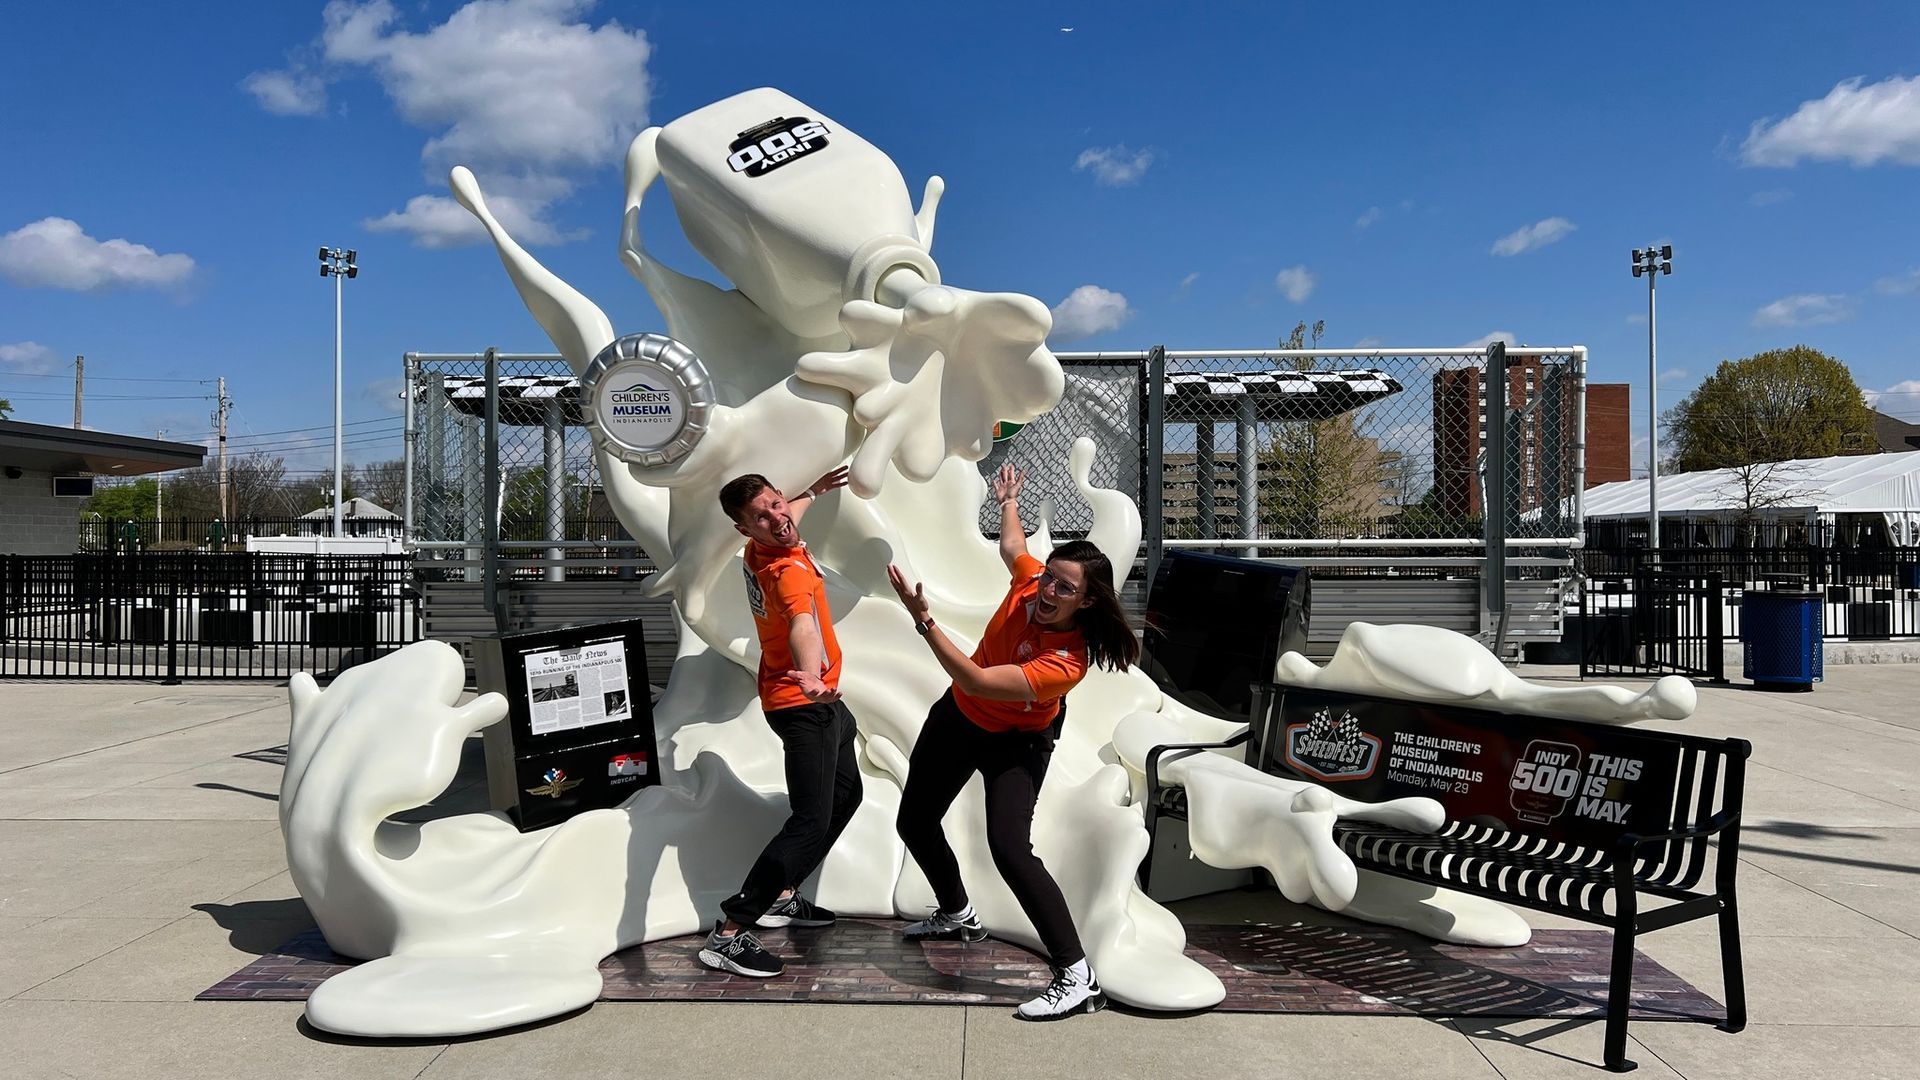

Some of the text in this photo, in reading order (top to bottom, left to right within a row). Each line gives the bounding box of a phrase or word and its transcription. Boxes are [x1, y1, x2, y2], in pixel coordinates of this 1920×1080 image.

[727, 122, 830, 172] 500
[761, 141, 812, 170] INDY
[612, 393, 670, 402] CHILDREN'S
[613, 405, 671, 415] MUSEUM
[543, 650, 608, 665] The Daily News
[1295, 734, 1369, 765] SPEEDFEST
[1391, 744, 1439, 761] MUSEUM
[1394, 732, 1482, 755] THE CHILDREN'S
[1389, 757, 1484, 782] OF INDIANAPOLIS
[1534, 750, 1571, 767] INDY
[1588, 753, 1644, 781] THIS
[610, 775, 637, 785] INDYCAR
[1387, 770, 1469, 794] Monday, May 29
[1511, 762, 1579, 798] 500
[1582, 775, 1608, 797] IS
[1575, 796, 1632, 825] MAY.
